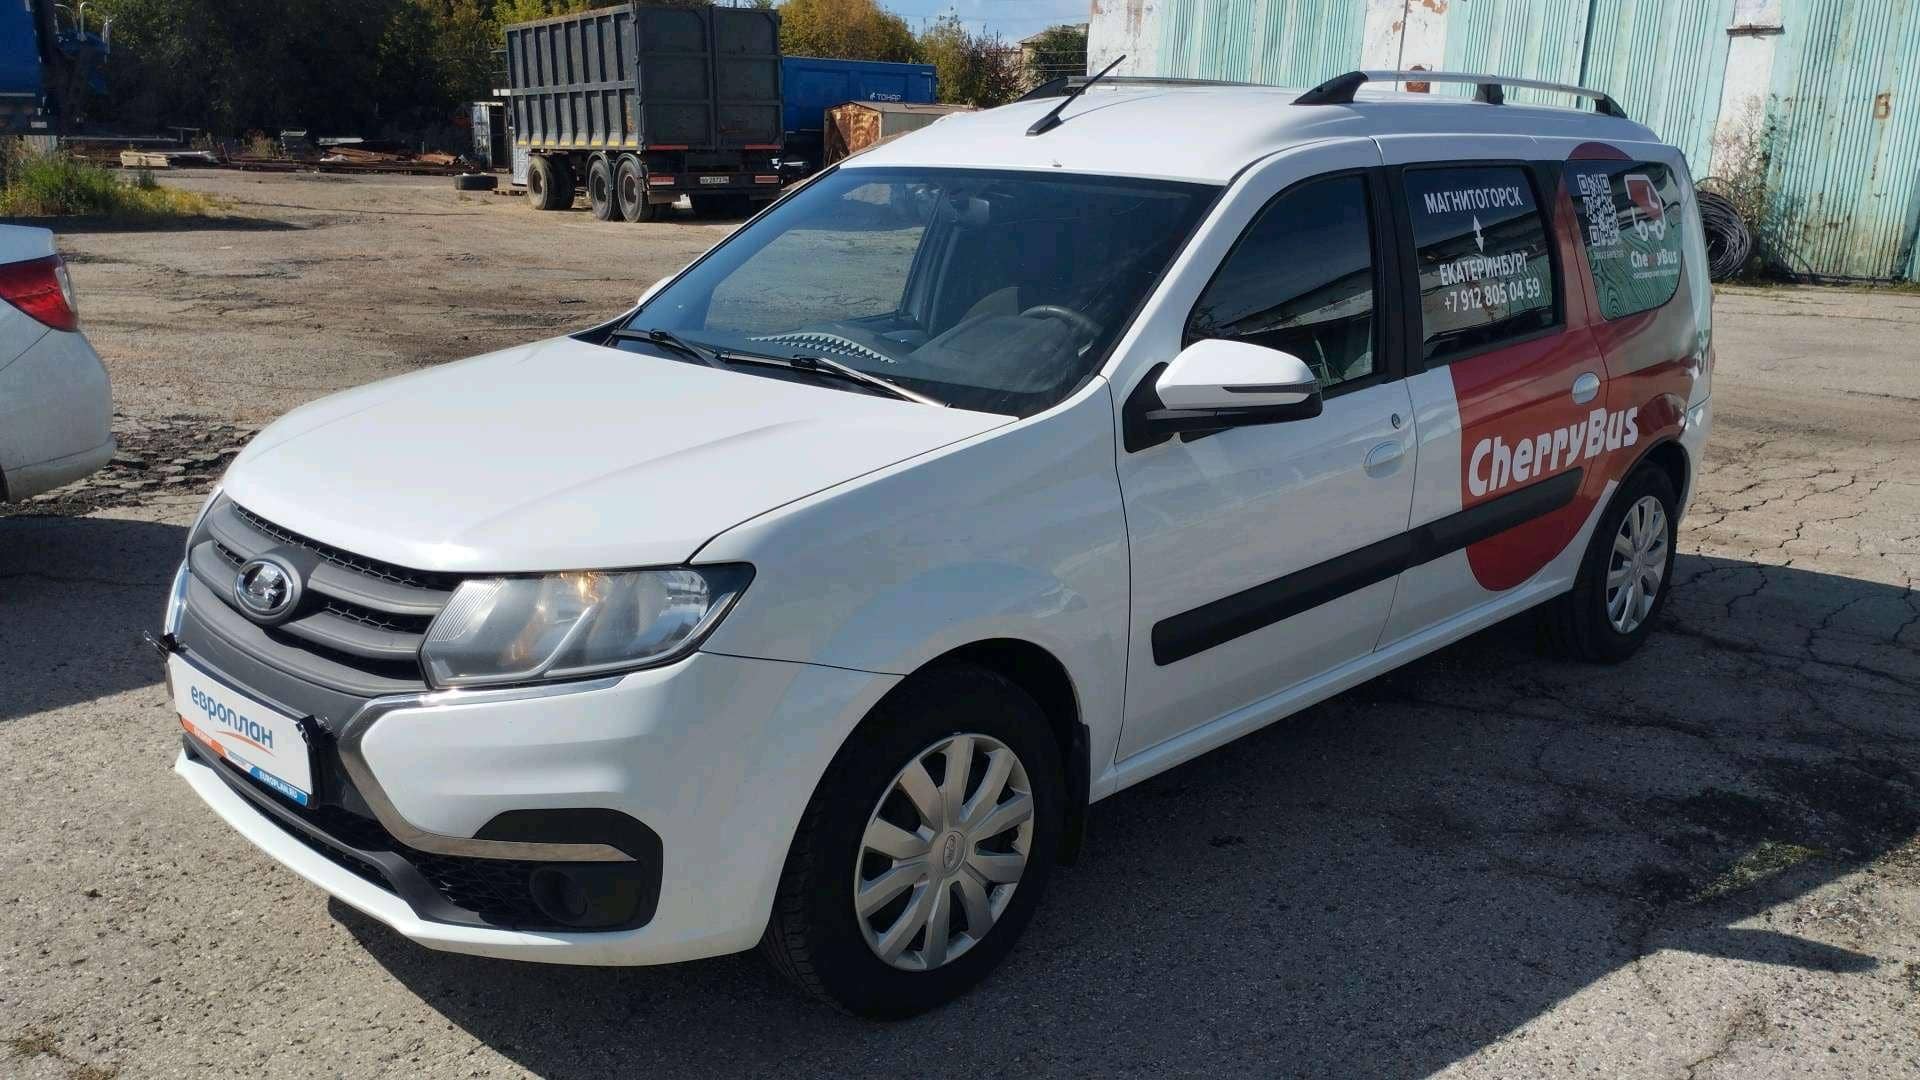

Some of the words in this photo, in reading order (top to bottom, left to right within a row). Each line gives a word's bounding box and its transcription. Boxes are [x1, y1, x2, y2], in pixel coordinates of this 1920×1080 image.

[1424, 186, 1523, 214] МАГНИТОГОРСК
[1439, 252, 1529, 286] ЕКАТЕРИНБУРГ
[1444, 291, 1458, 313] +7
[1462, 286, 1482, 309] 912
[1484, 282, 1507, 306] 805
[1508, 279, 1525, 301] 04
[1525, 277, 1540, 299] 59
[1468, 406, 1639, 497] CherryBus
[191, 685, 274, 750] европлан
